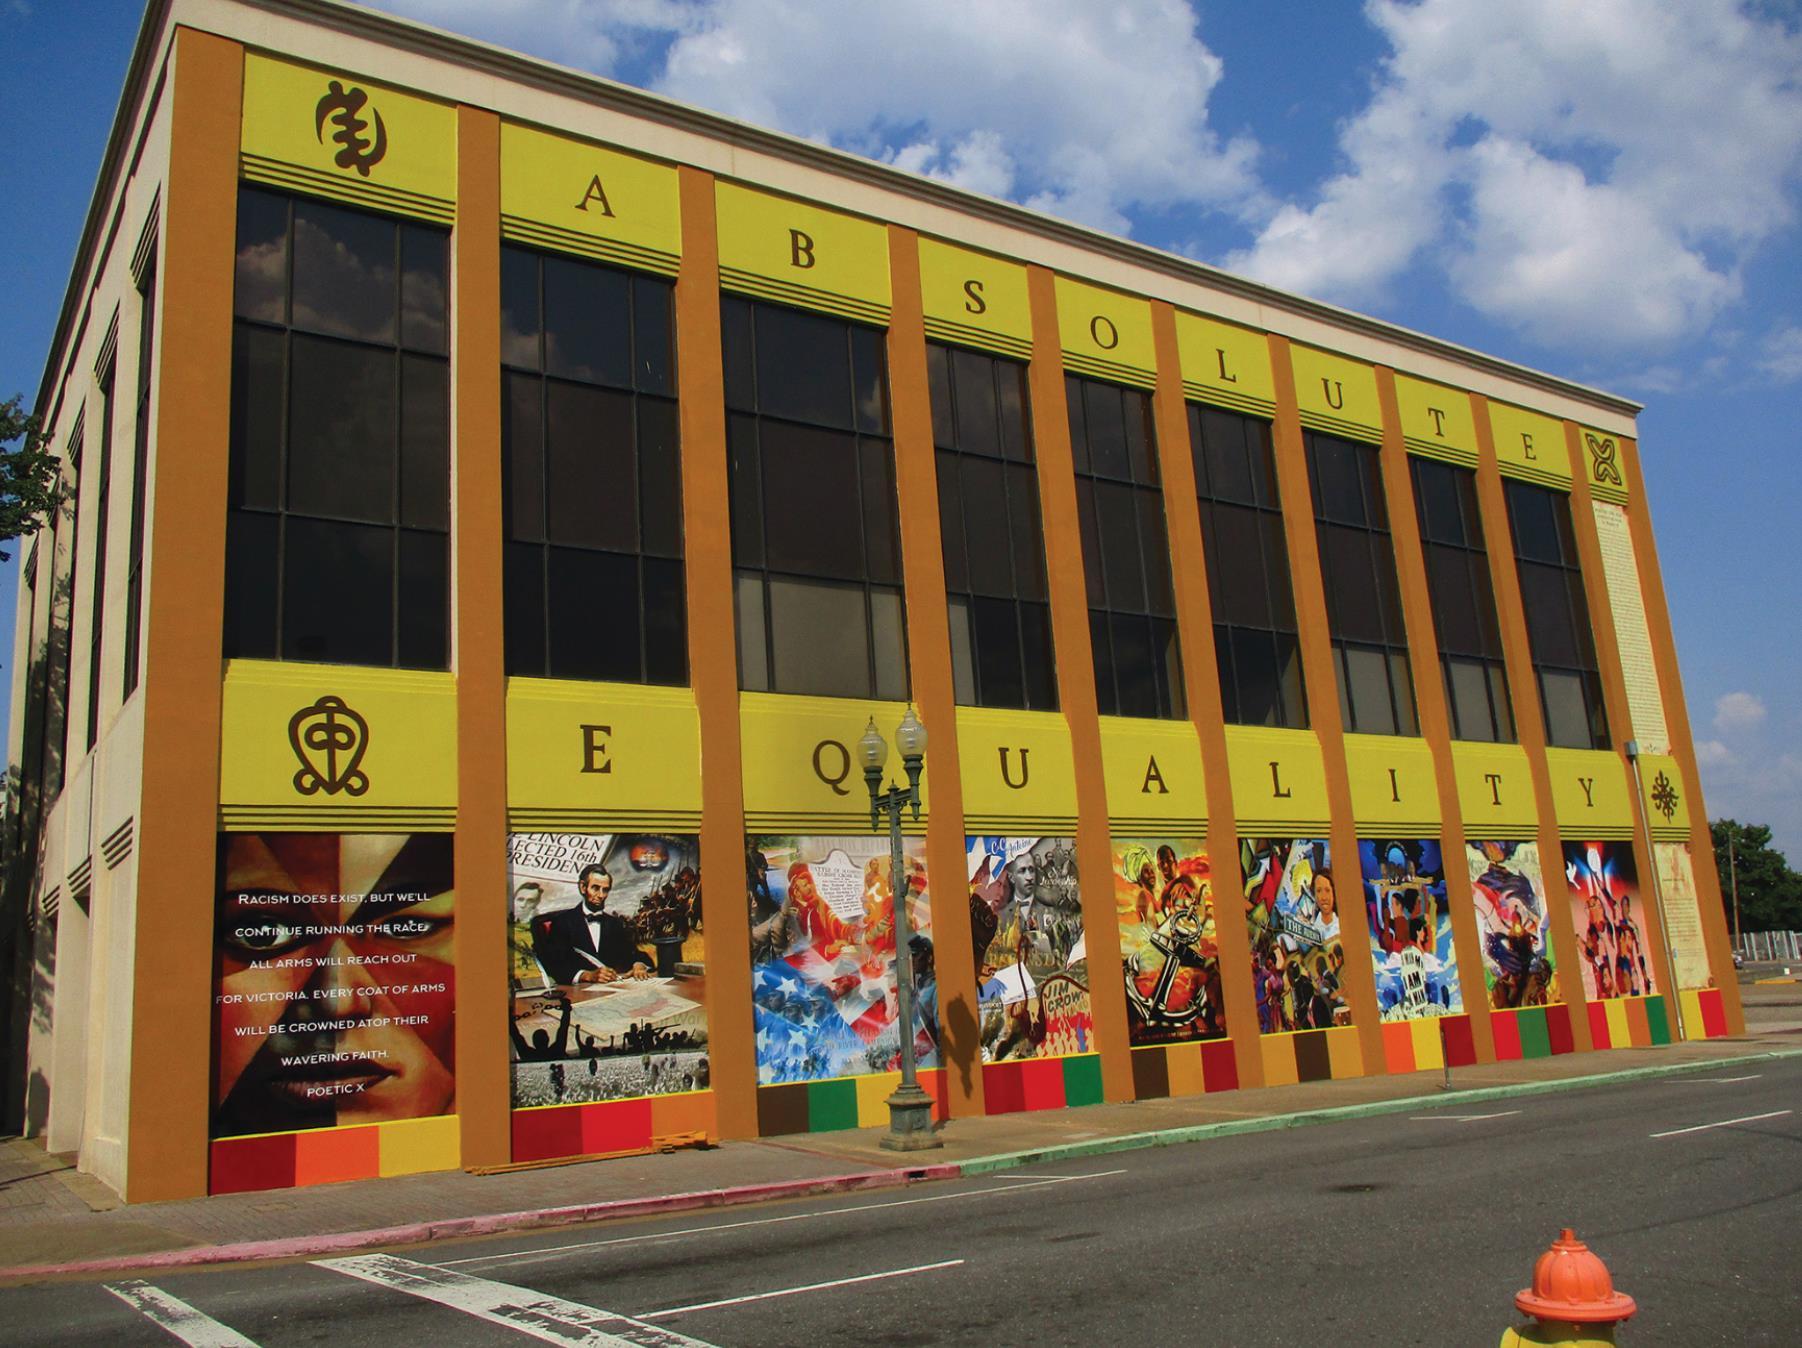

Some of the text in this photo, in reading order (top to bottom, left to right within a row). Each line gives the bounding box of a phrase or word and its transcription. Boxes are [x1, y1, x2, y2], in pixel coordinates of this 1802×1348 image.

[506, 852, 585, 874] RESIDEN
[570, 849, 597, 863] 16th
[239, 894, 289, 904] RACISM
[293, 894, 327, 904] DOES
[370, 893, 394, 903] BUT
[397, 892, 430, 901] WE'LL
[235, 926, 302, 937] CONTINUE
[306, 924, 364, 935] RUNNING
[367, 924, 390, 932] THE
[1287, 919, 1301, 935] THE
[250, 954, 417, 969] ALL ARMS WILL REACH OUT
[216, 995, 242, 1004] FOR
[314, 988, 353, 999] EVERY
[357, 986, 389, 996] COAT
[392, 985, 408, 994] OF
[412, 983, 446, 993] ARMS
[1044, 983, 1069, 999] JIM
[1048, 993, 1080, 1013] CROW
[235, 1015, 428, 1036] WILL BE CROWNED ATOP THEIR
[281, 1050, 389, 1066] WAVERING FAITH.
[307, 1083, 364, 1097] POETIC X
